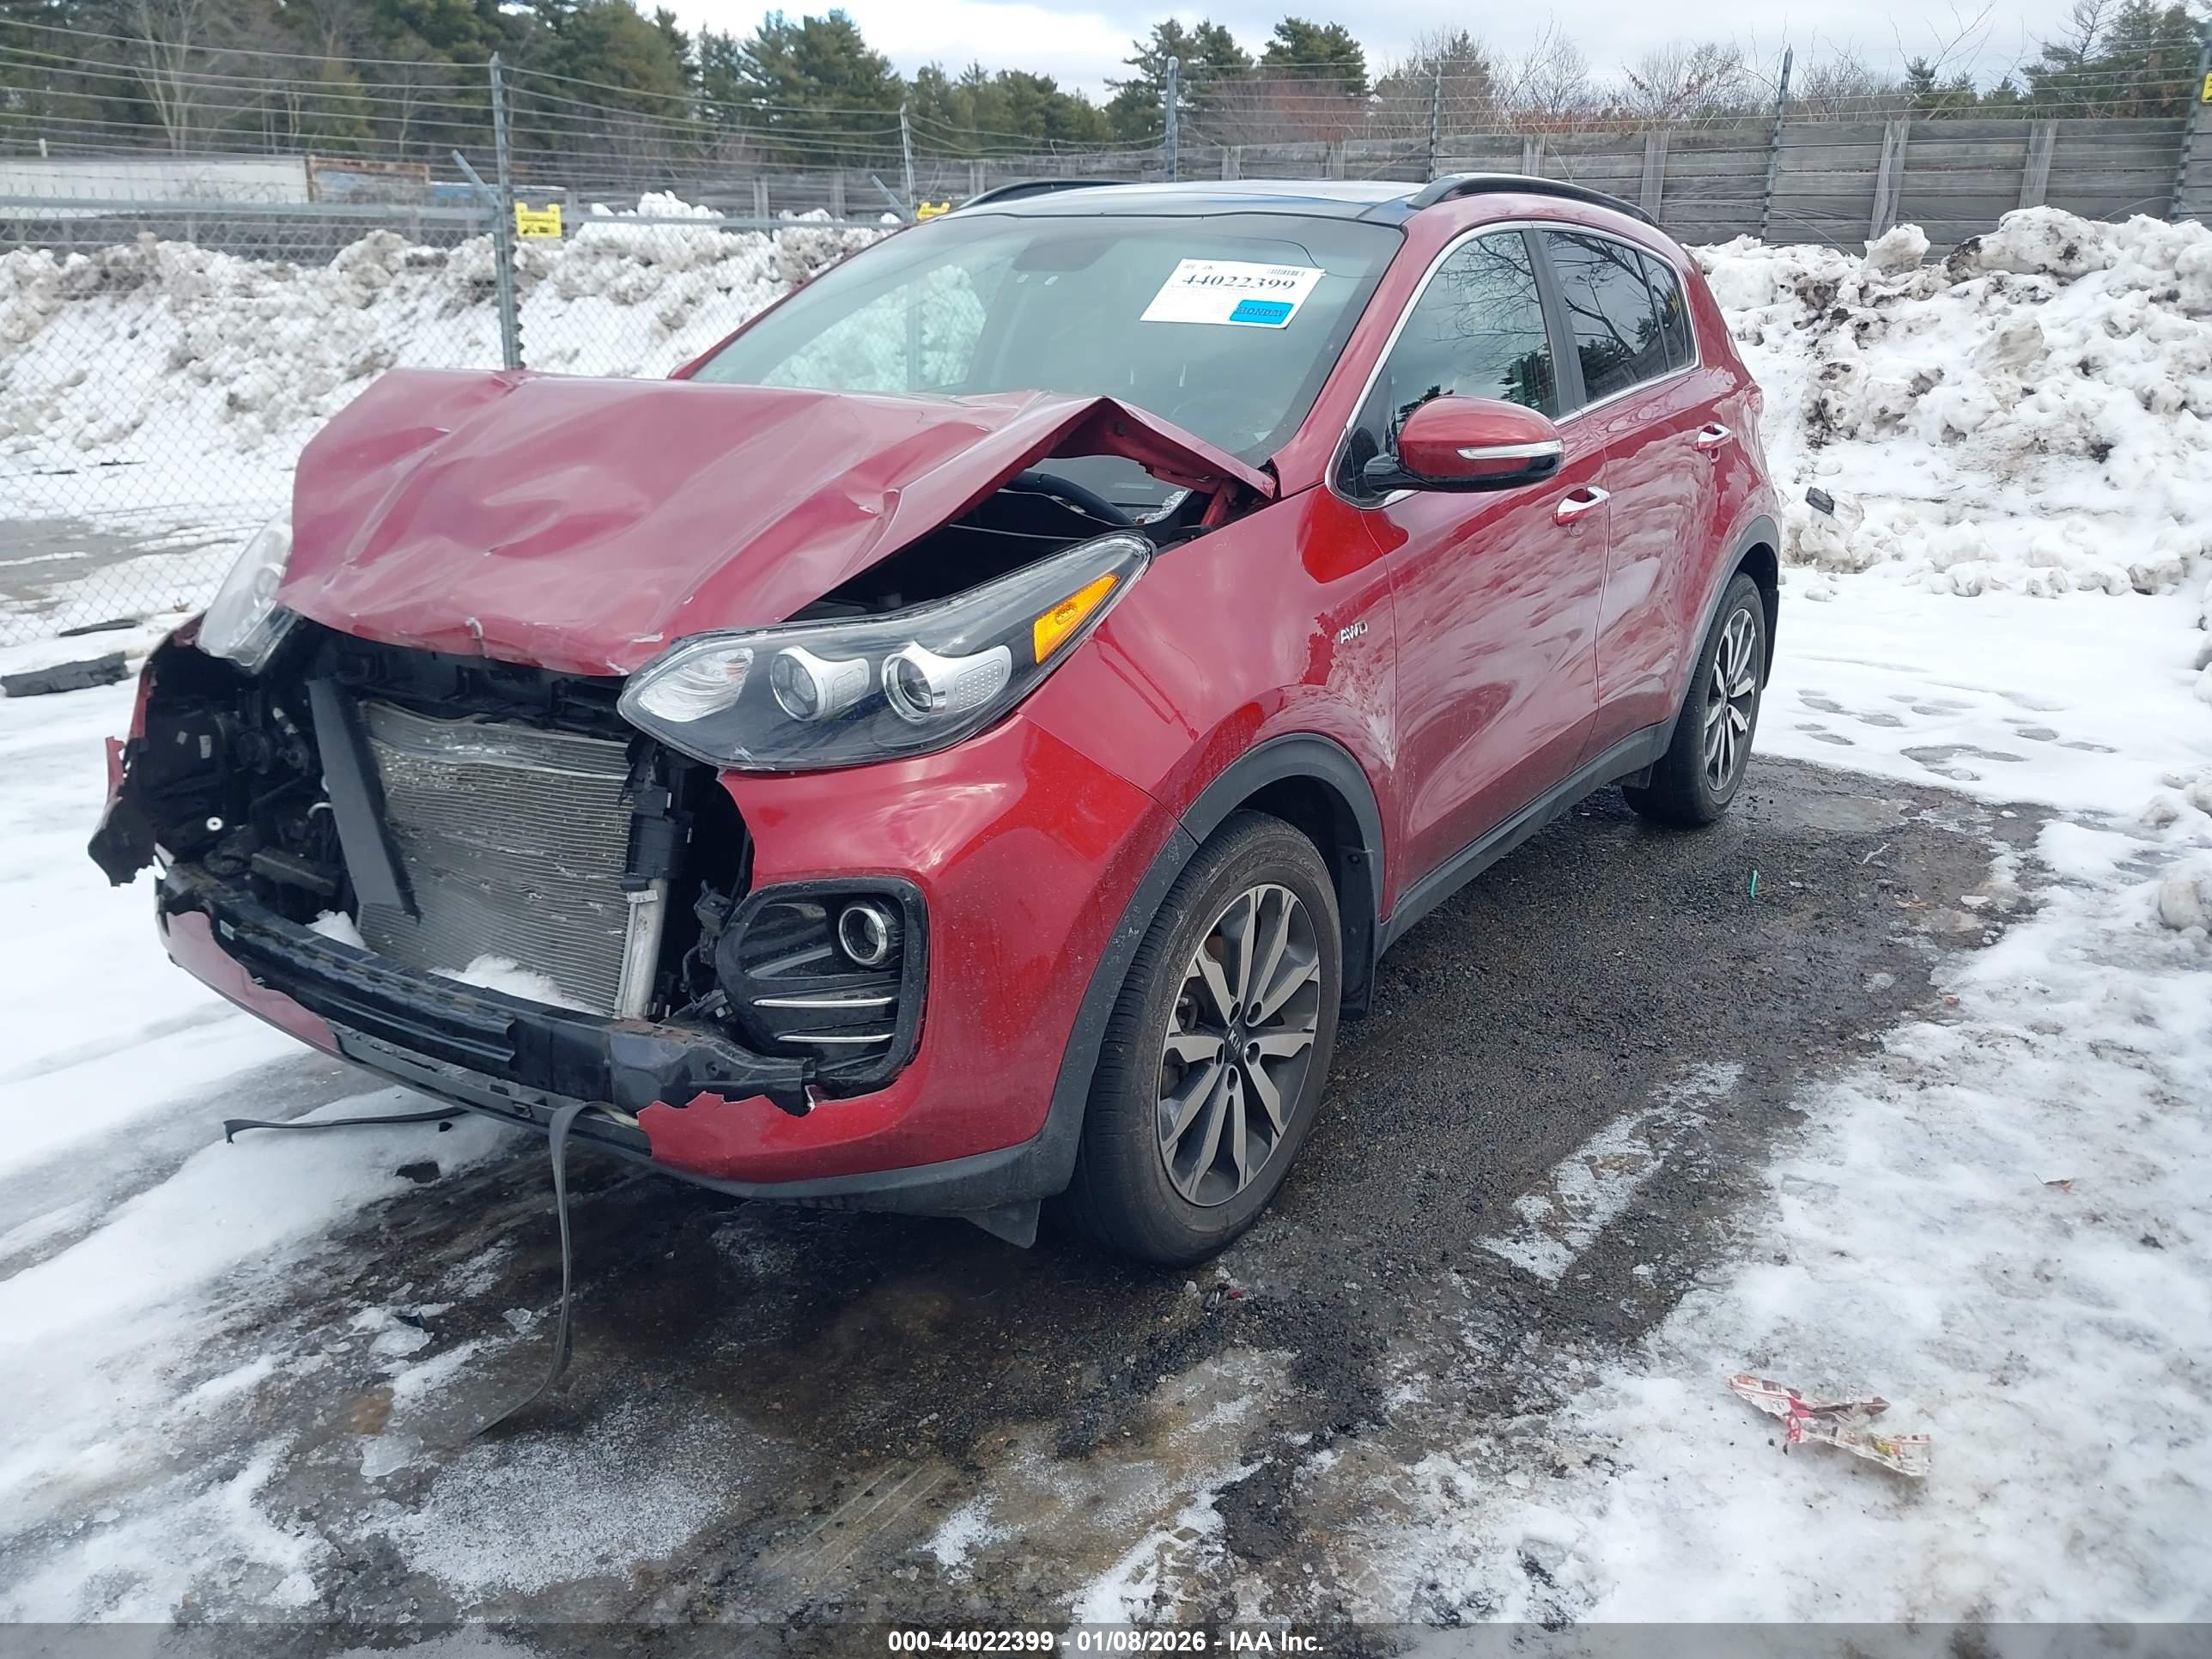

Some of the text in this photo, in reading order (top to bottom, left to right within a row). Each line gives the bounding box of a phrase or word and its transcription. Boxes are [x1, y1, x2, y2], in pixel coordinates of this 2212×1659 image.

[1182, 274, 1295, 289] 44022399
[1340, 620, 1368, 644] AWD
[1229, 1029, 1241, 1054] KIA
